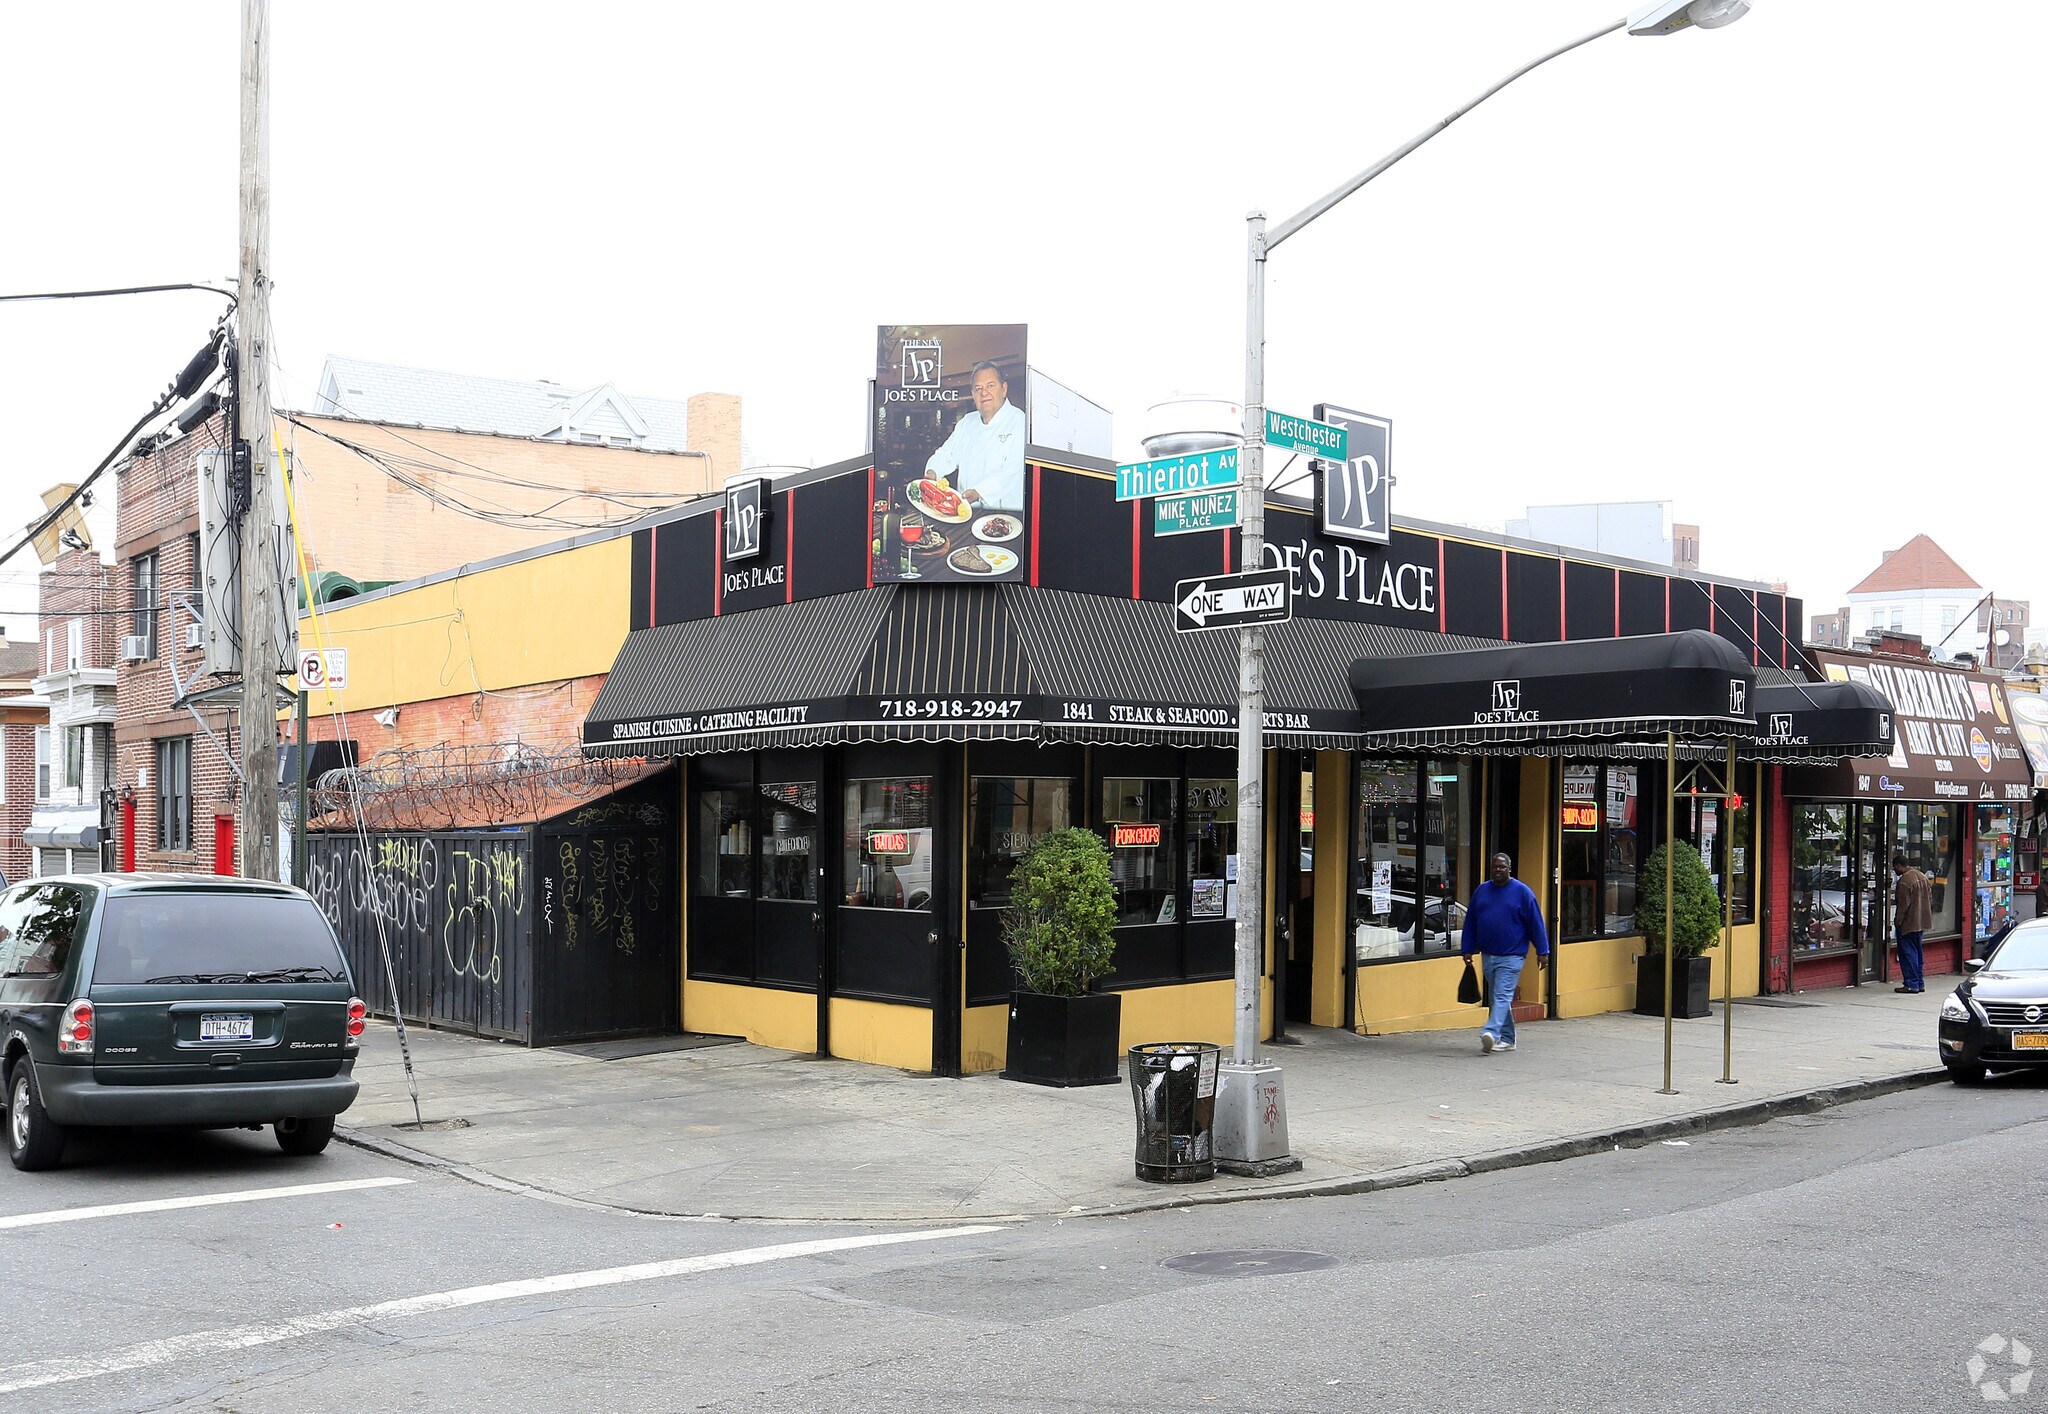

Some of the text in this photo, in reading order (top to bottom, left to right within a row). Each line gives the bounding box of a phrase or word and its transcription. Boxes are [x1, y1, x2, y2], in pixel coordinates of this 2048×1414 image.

[883, 388, 959, 405] JOE'S PLACE
[1269, 413, 1342, 449] Westchester
[1292, 440, 1319, 456] Avenue
[1120, 453, 1236, 497] Thieriot Av
[1158, 493, 1233, 521] MIKE NUÑEZ
[1178, 515, 1211, 529] PLACE
[723, 565, 784, 599] JOE'S PLACE
[1263, 538, 1435, 613] E'S PLACE
[1190, 586, 1280, 614] ONE WAY
[1869, 663, 1976, 723] SILBERMAN'S
[613, 705, 809, 739] SPANISH CUISINE CATERING FACILITY
[879, 699, 1023, 718] 718-918-2947
[1062, 702, 1311, 729] 1841 STEAK & SEAFOOD RTS BAR
[1474, 710, 1540, 724] JOE'S PLACE
[1754, 735, 1809, 746] JOE'S PLACE
[1903, 720, 1971, 757] ARMY & NAVY
[1858, 775, 1871, 791] 1847
[1117, 826, 1160, 845] PORK CHOPS
[2020, 841, 2037, 851] EXIT
